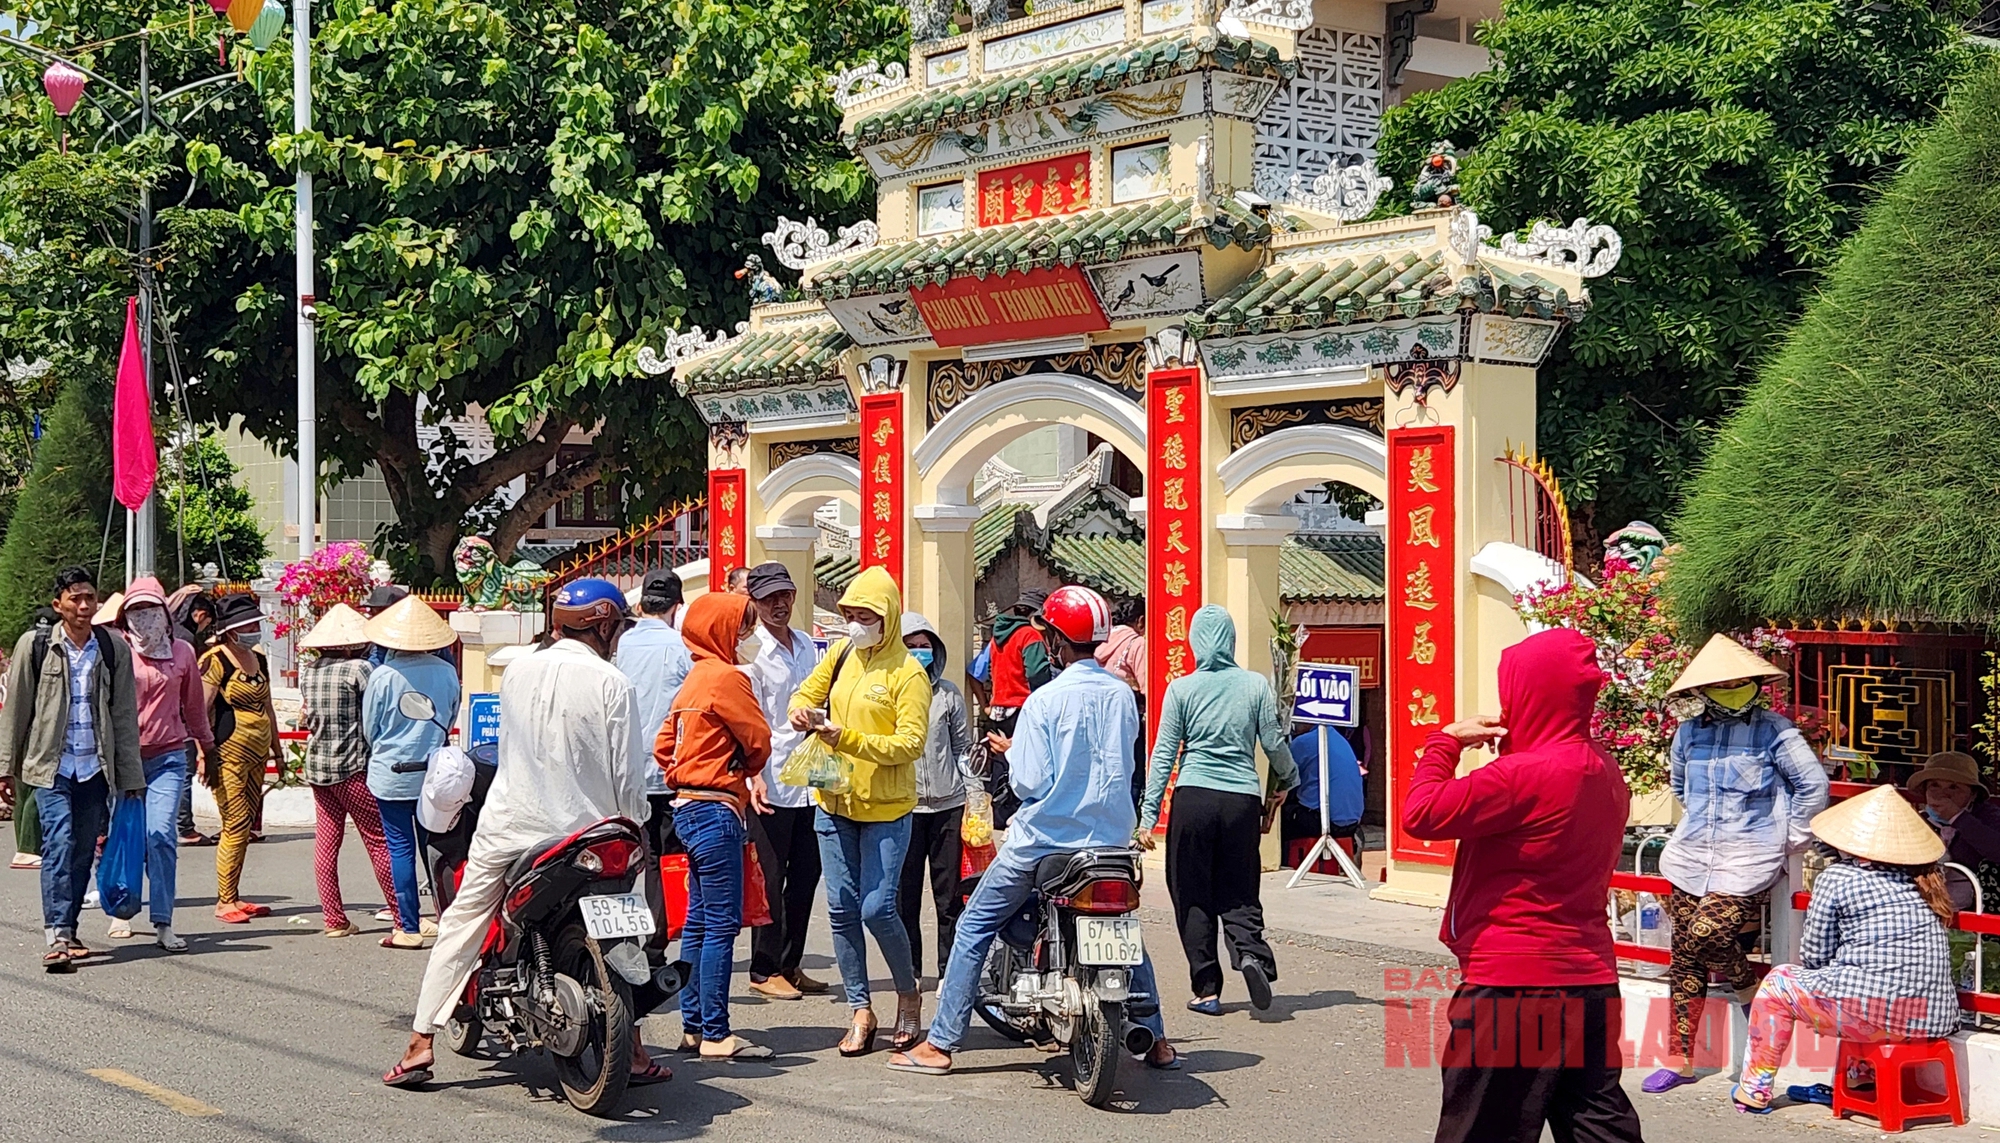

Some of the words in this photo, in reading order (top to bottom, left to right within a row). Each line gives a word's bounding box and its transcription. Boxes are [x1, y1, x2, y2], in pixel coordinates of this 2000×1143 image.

[922, 290, 971, 331] CHÚA
[964, 285, 991, 327] XỨ
[990, 280, 1055, 323] THÁNH
[1044, 269, 1092, 317] MIẾU
[1319, 674, 1350, 701] VÀO
[591, 915, 649, 936] 104.56
[1083, 942, 1138, 961] 110.62
